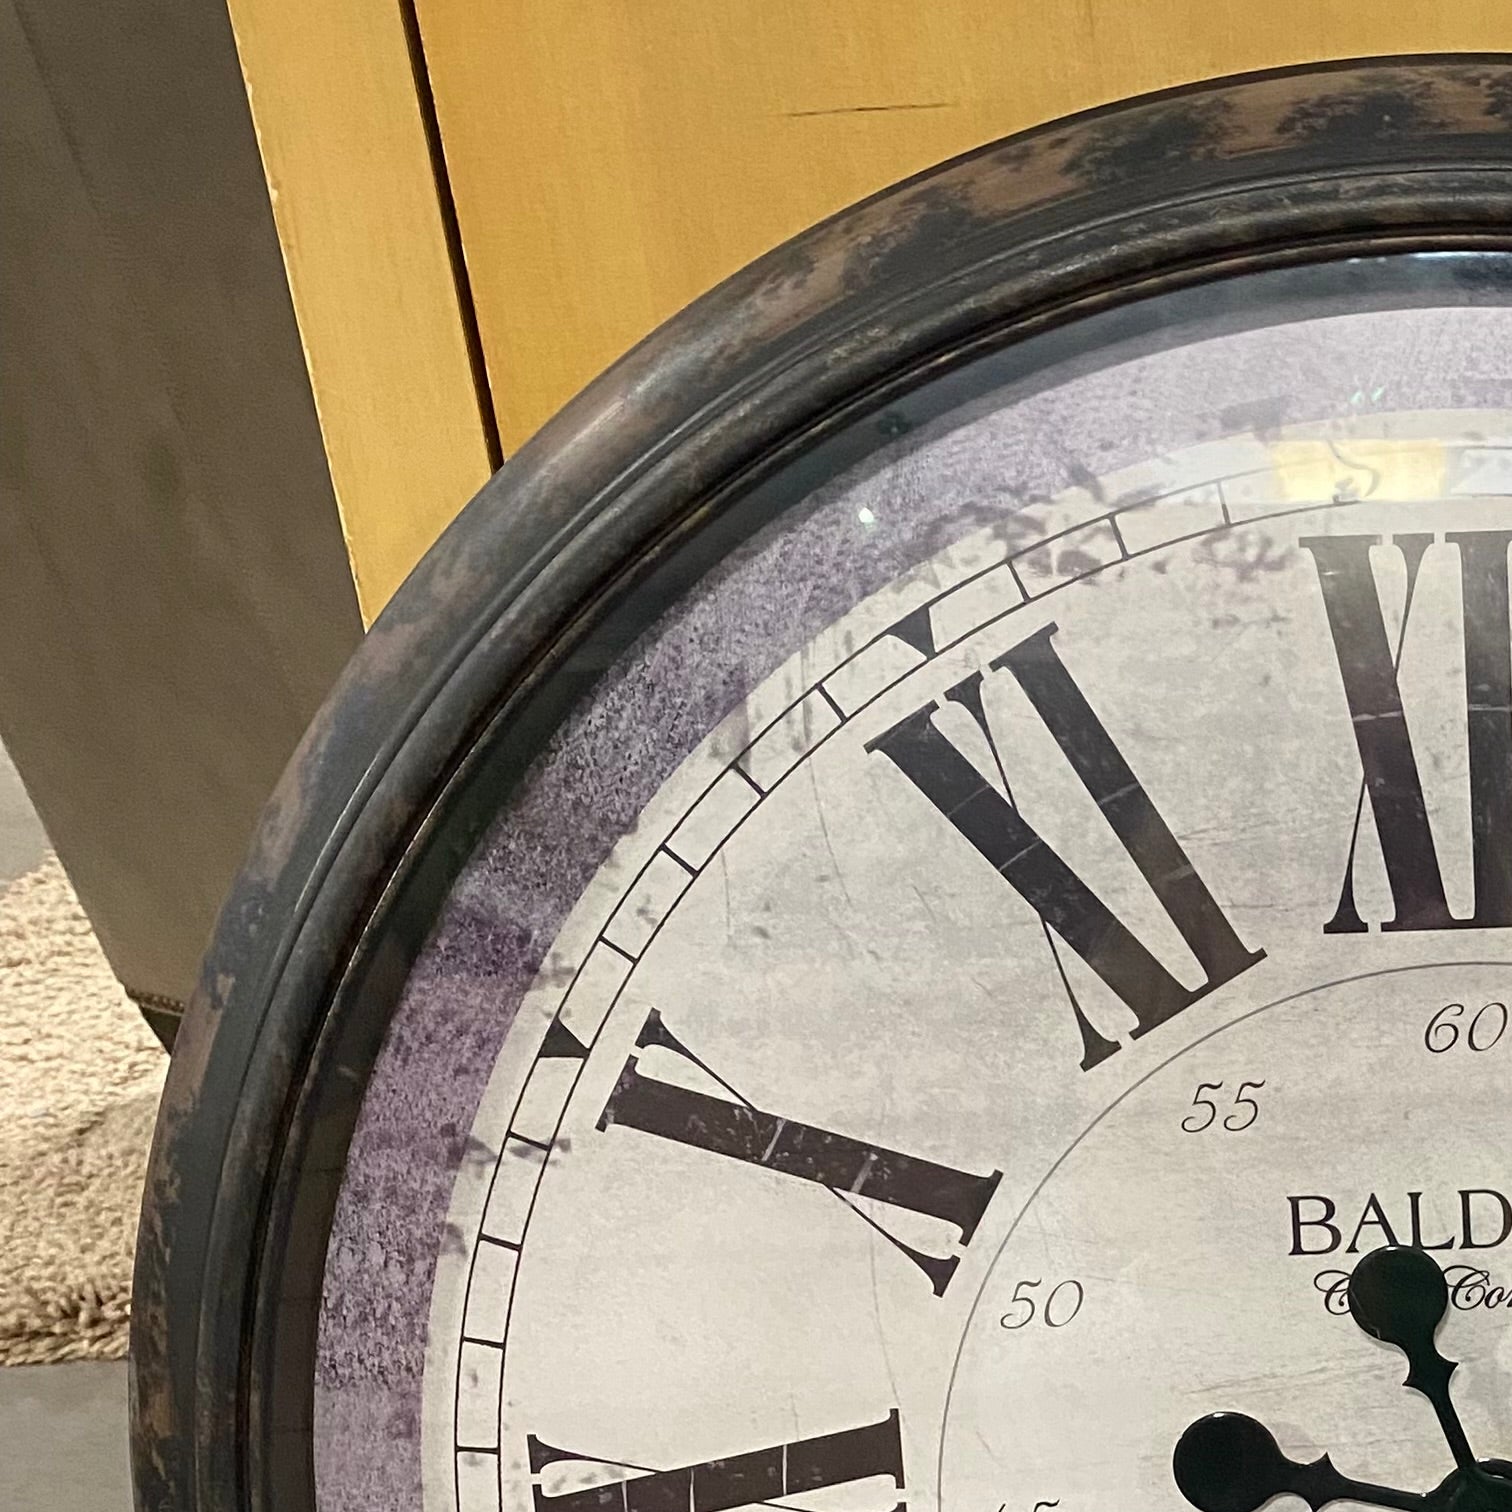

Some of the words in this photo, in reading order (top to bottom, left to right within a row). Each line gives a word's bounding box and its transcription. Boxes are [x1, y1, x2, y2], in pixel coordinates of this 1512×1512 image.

[864, 622, 1267, 1072] XI
[1423, 1002, 1508, 1054] 60
[1180, 1079, 1266, 1133] 55
[595, 1007, 1003, 1297] X
[999, 1279, 1085, 1330] 50
